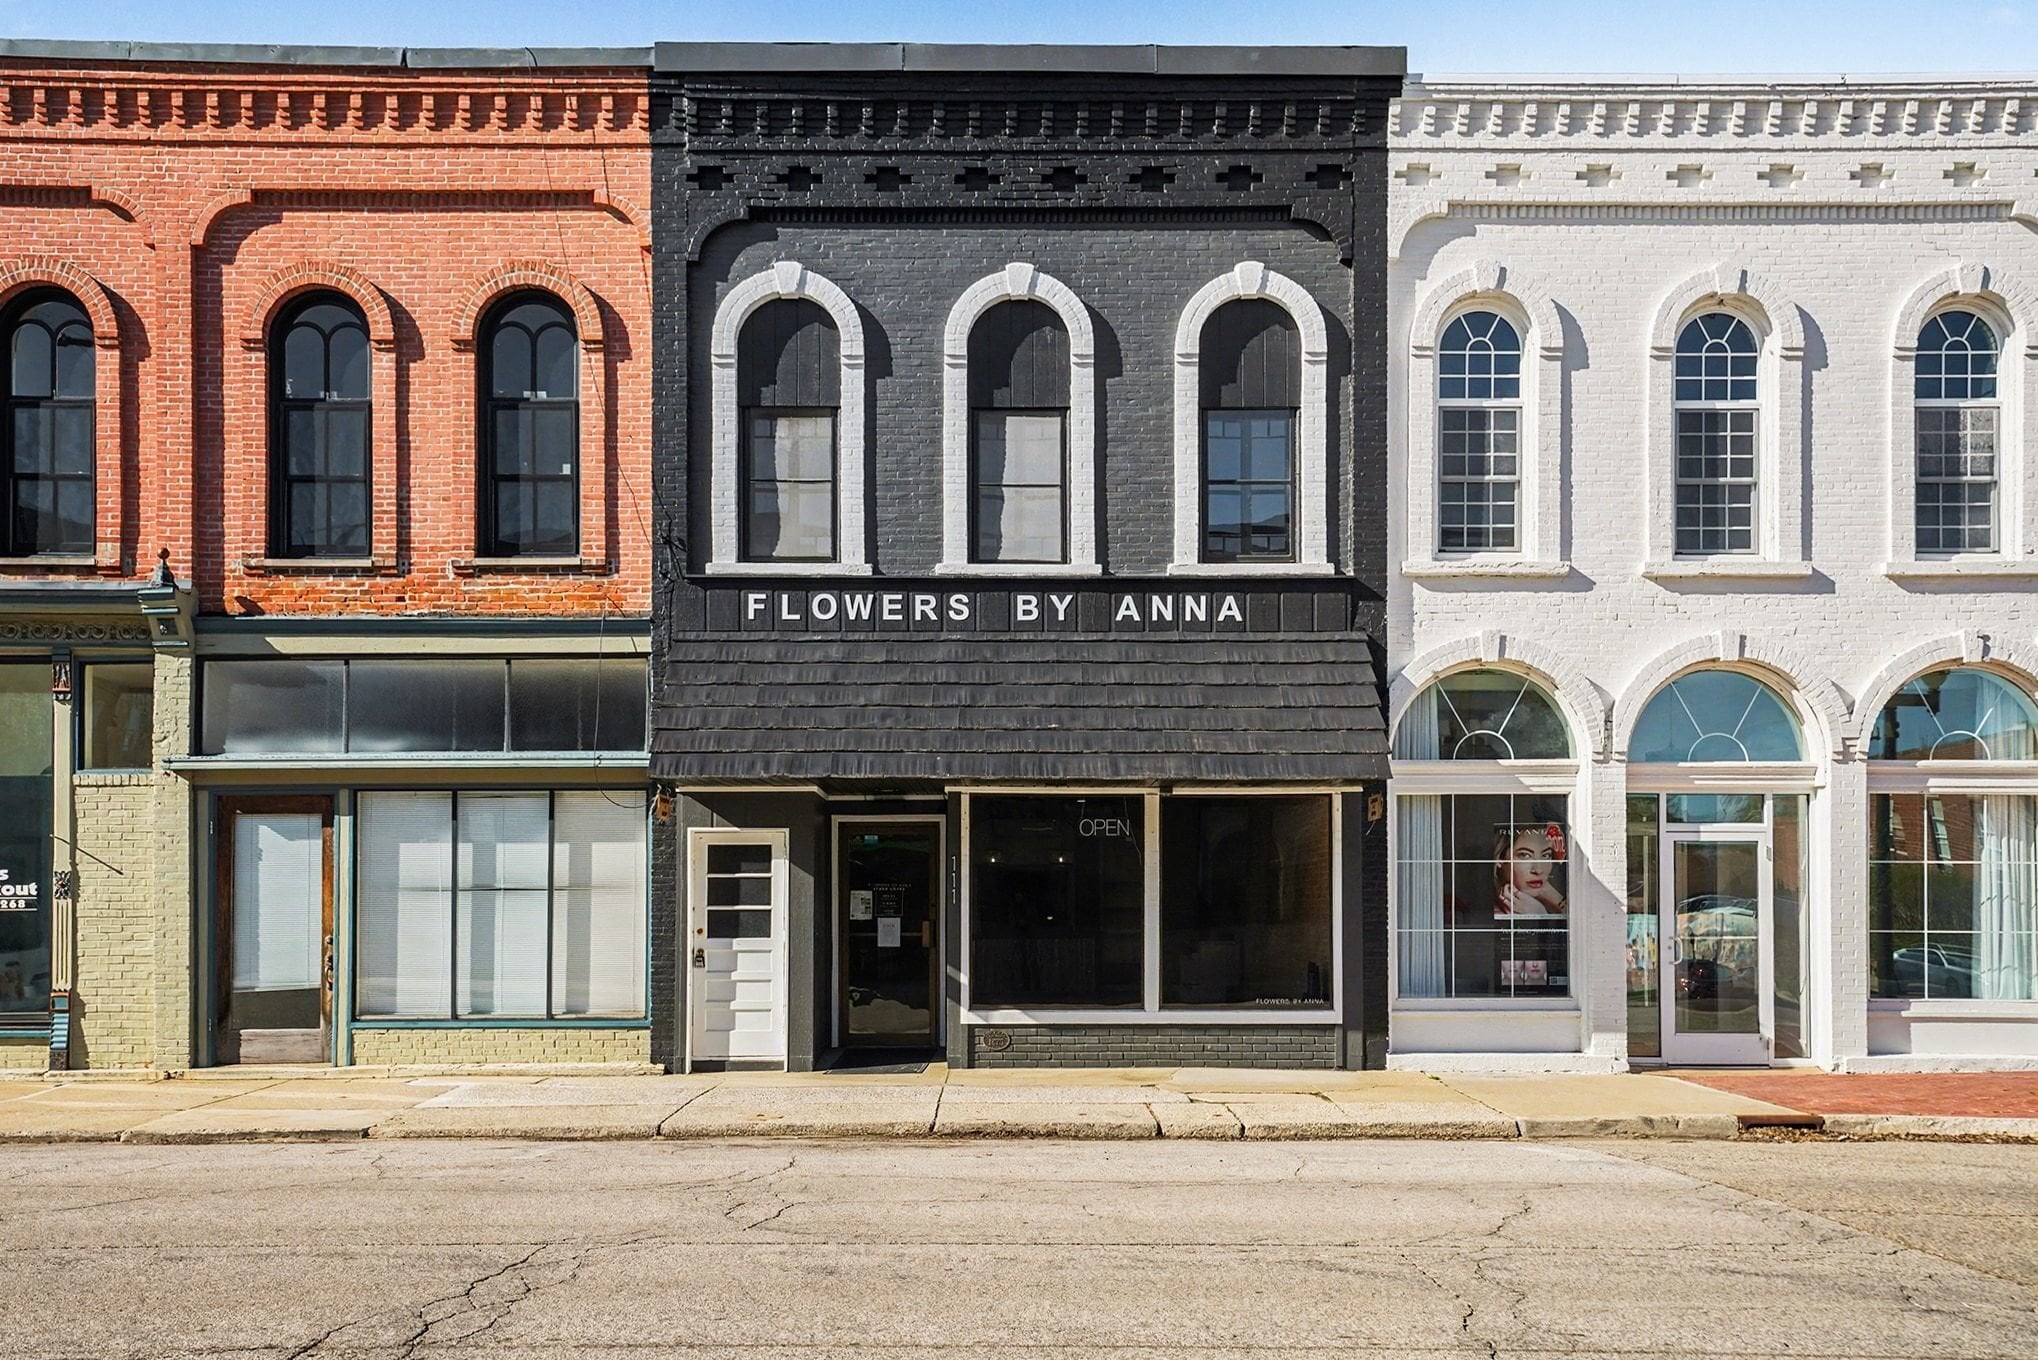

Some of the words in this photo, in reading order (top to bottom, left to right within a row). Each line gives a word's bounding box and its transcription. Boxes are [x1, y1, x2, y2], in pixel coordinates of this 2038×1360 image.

[747, 593, 972, 621] FLOWERS
[1016, 594, 1074, 621] BY
[1115, 595, 1244, 622] ANNA
[1079, 818, 1130, 837] OPEN
